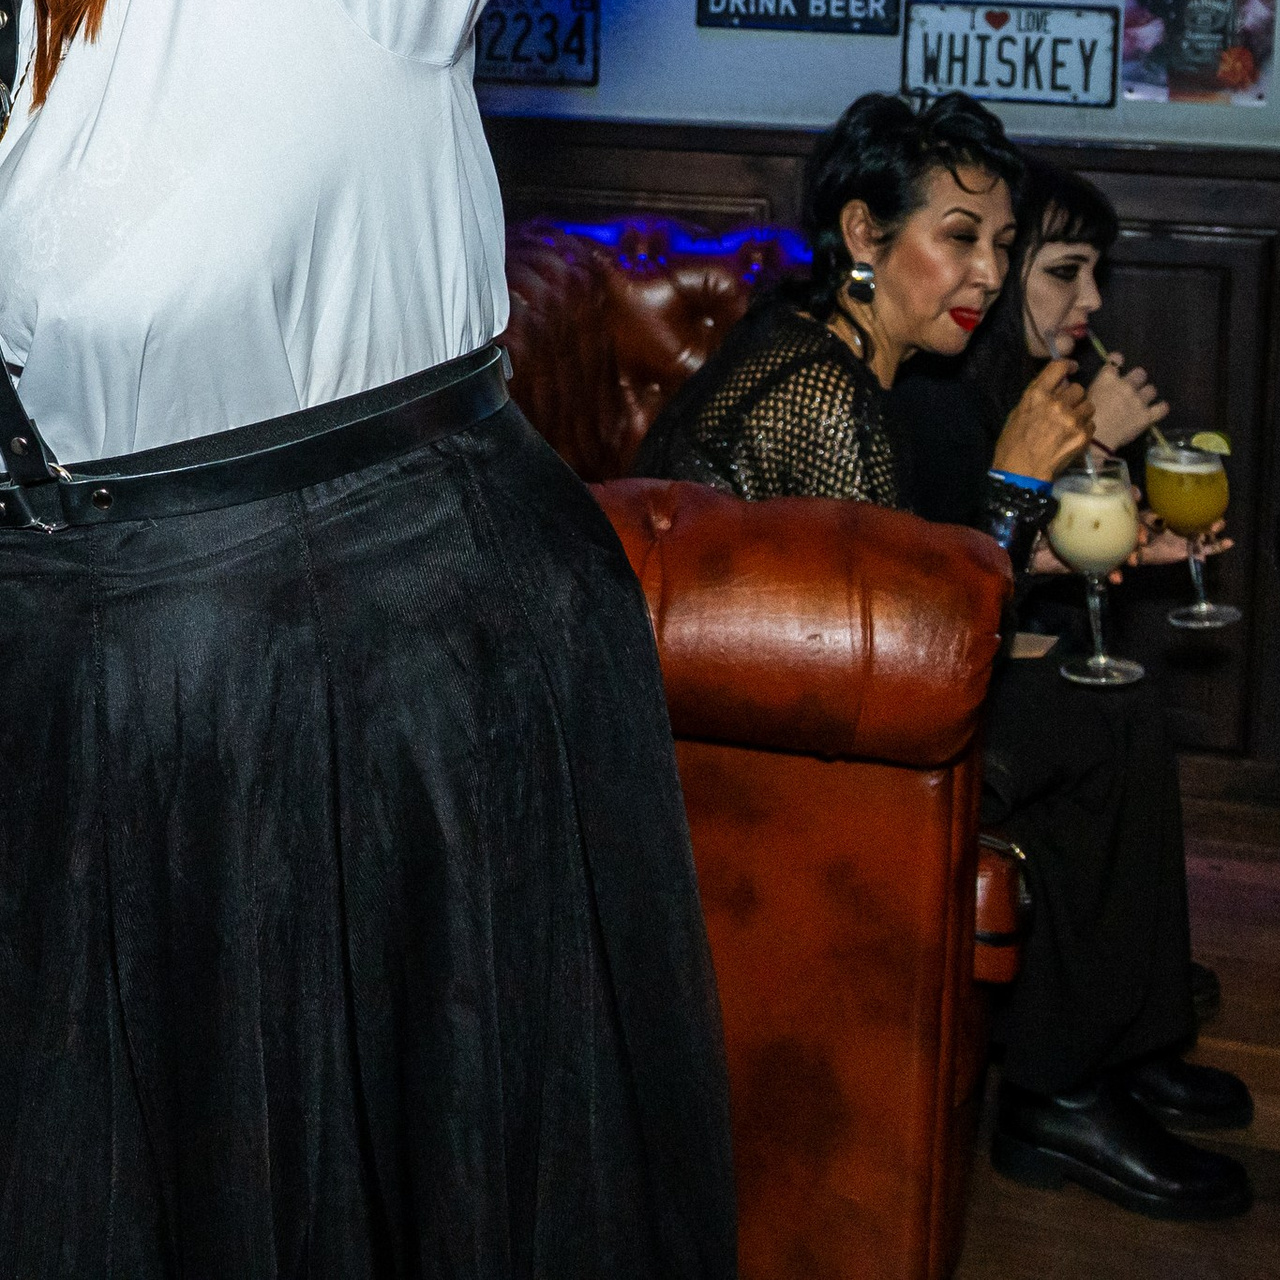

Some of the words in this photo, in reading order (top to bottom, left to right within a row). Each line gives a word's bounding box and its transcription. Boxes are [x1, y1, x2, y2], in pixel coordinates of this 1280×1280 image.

[970, 8, 978, 31] I
[1016, 9, 1051, 35] LOVE
[922, 31, 1099, 94] WHISKEY
